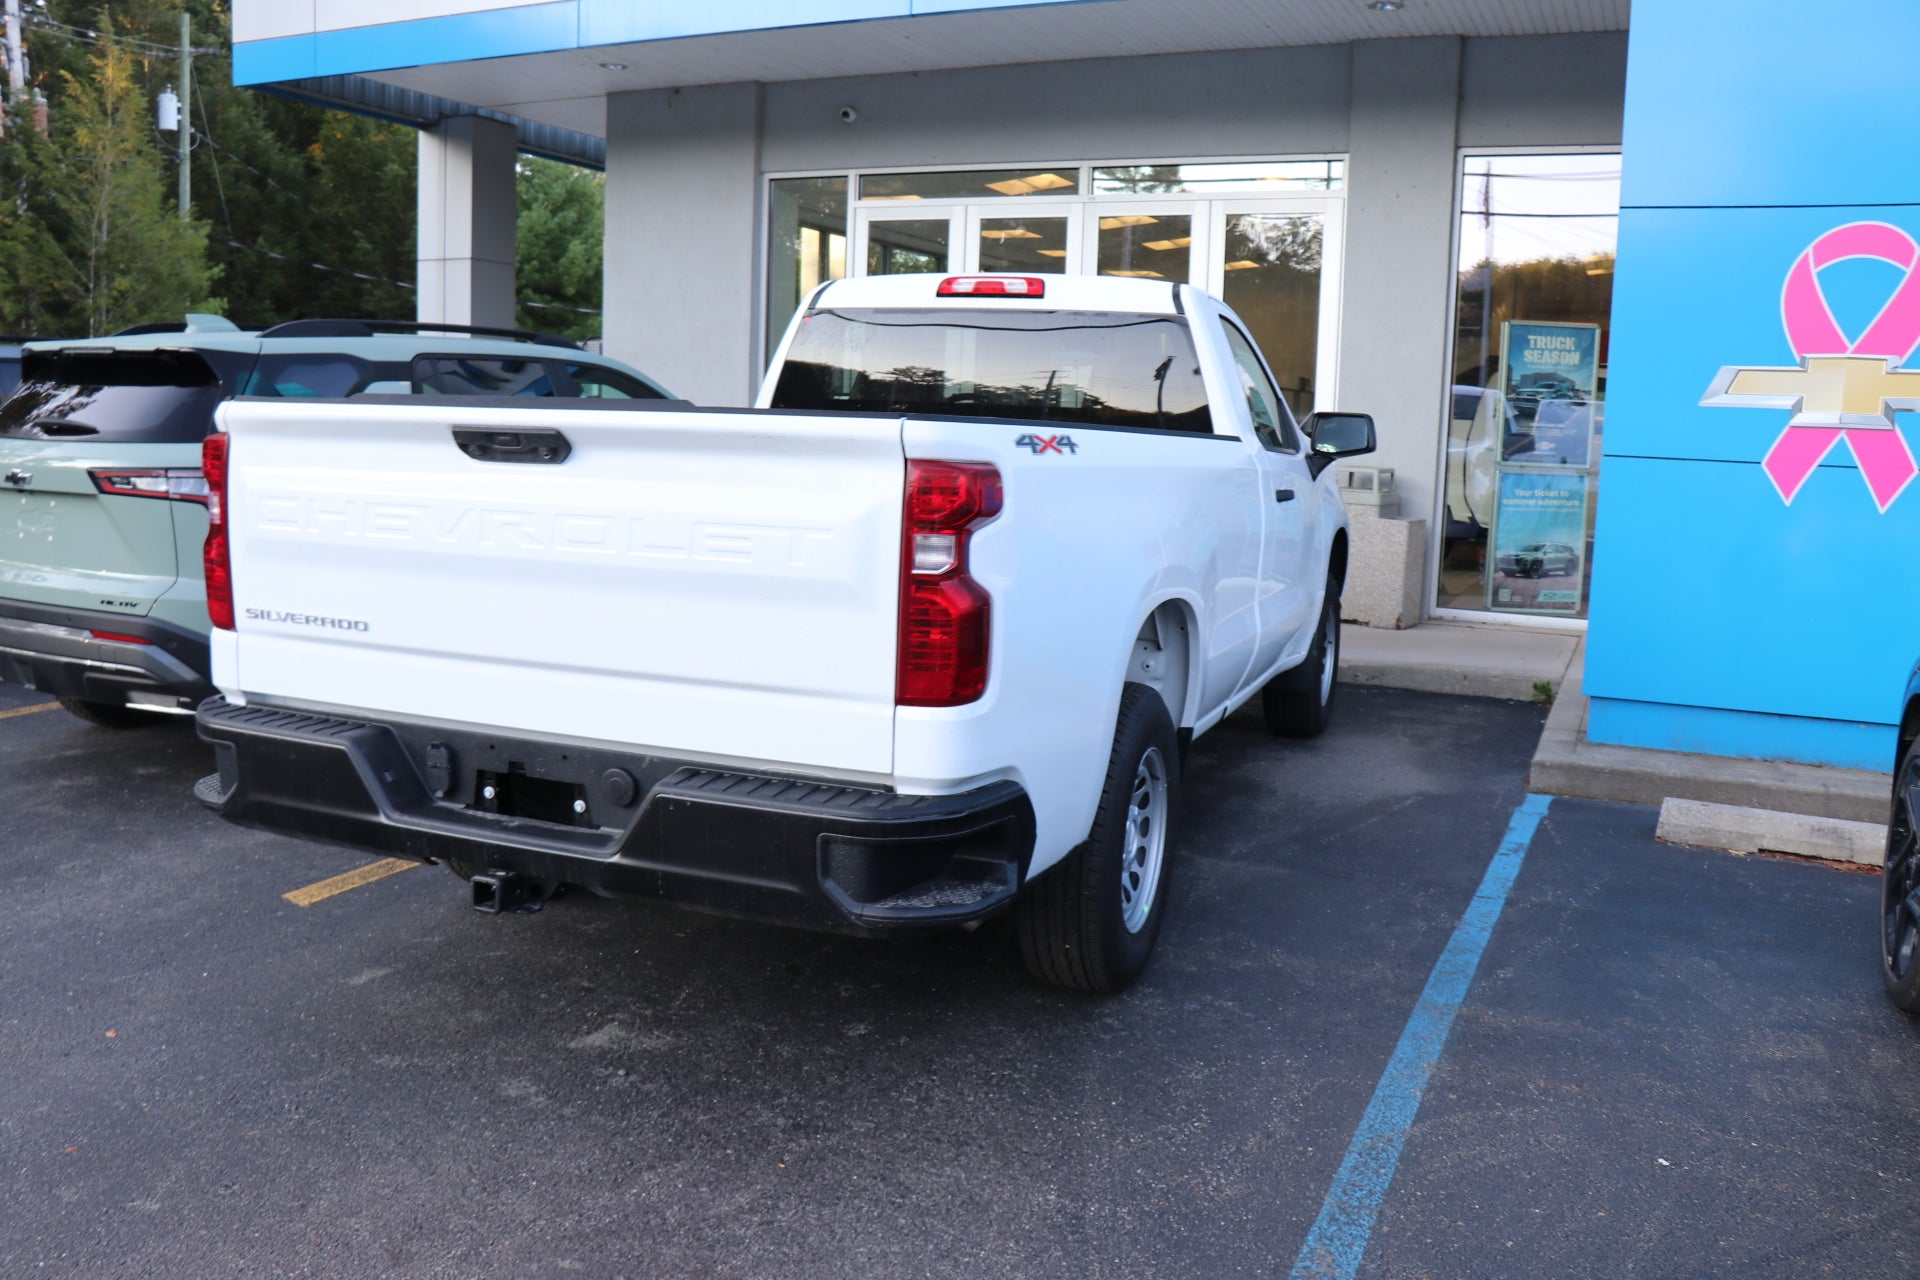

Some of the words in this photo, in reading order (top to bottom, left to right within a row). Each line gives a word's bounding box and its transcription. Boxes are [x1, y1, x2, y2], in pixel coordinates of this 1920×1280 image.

[1527, 335, 1576, 351] TRUCK
[1523, 349, 1581, 365] SEASON
[1515, 489, 1534, 497] Your
[1535, 489, 1559, 497] ticket
[1560, 489, 1570, 497] to
[257, 495, 834, 566] CHEVROLET
[245, 608, 370, 632] SILVERADO
